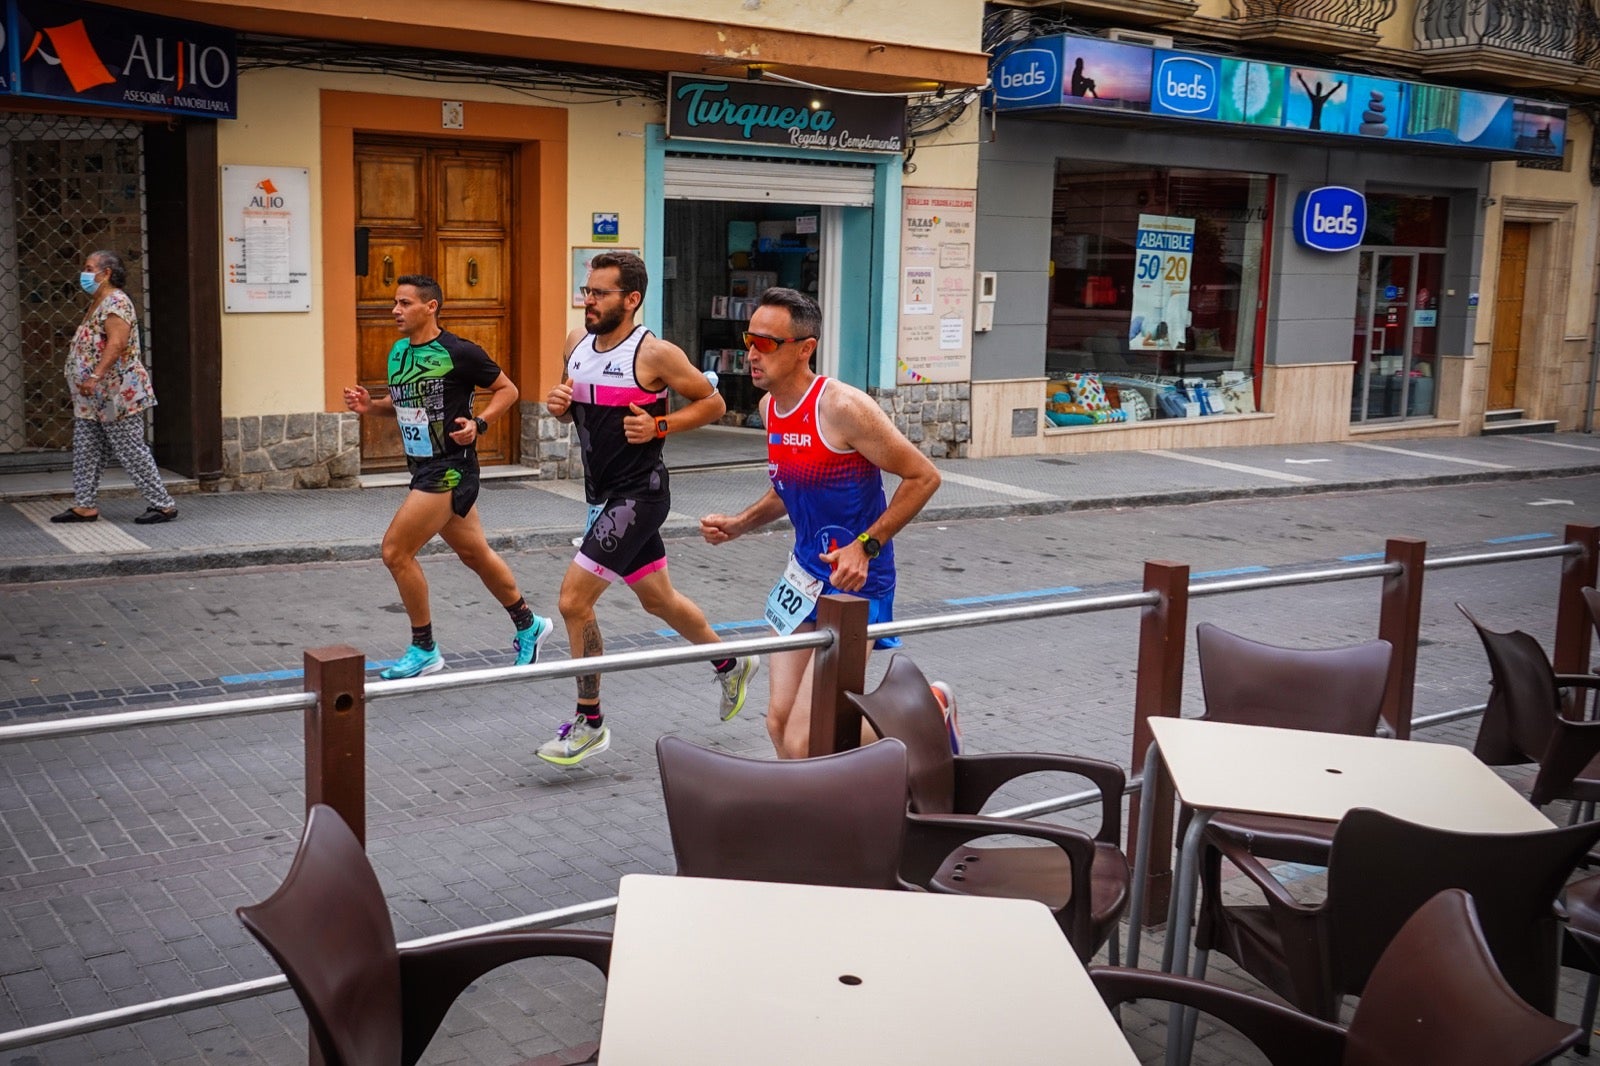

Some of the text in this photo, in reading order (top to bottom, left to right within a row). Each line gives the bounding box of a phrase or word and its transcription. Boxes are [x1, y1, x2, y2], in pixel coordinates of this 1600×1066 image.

[122, 34, 230, 92] ALJIO
[1000, 62, 1046, 89] bed's
[1166, 71, 1207, 100] bed's
[173, 95, 230, 112] INMOBILIARIA
[676, 82, 836, 139] Turquesa
[788, 126, 901, 151] Regalos y Complementos
[907, 218, 933, 227] TAZAS
[1312, 202, 1358, 235] bed's
[1139, 231, 1192, 250] ABATIBLE
[1137, 254, 1187, 281] 50 20
[782, 433, 812, 447] SEUR
[777, 584, 803, 615] 120
